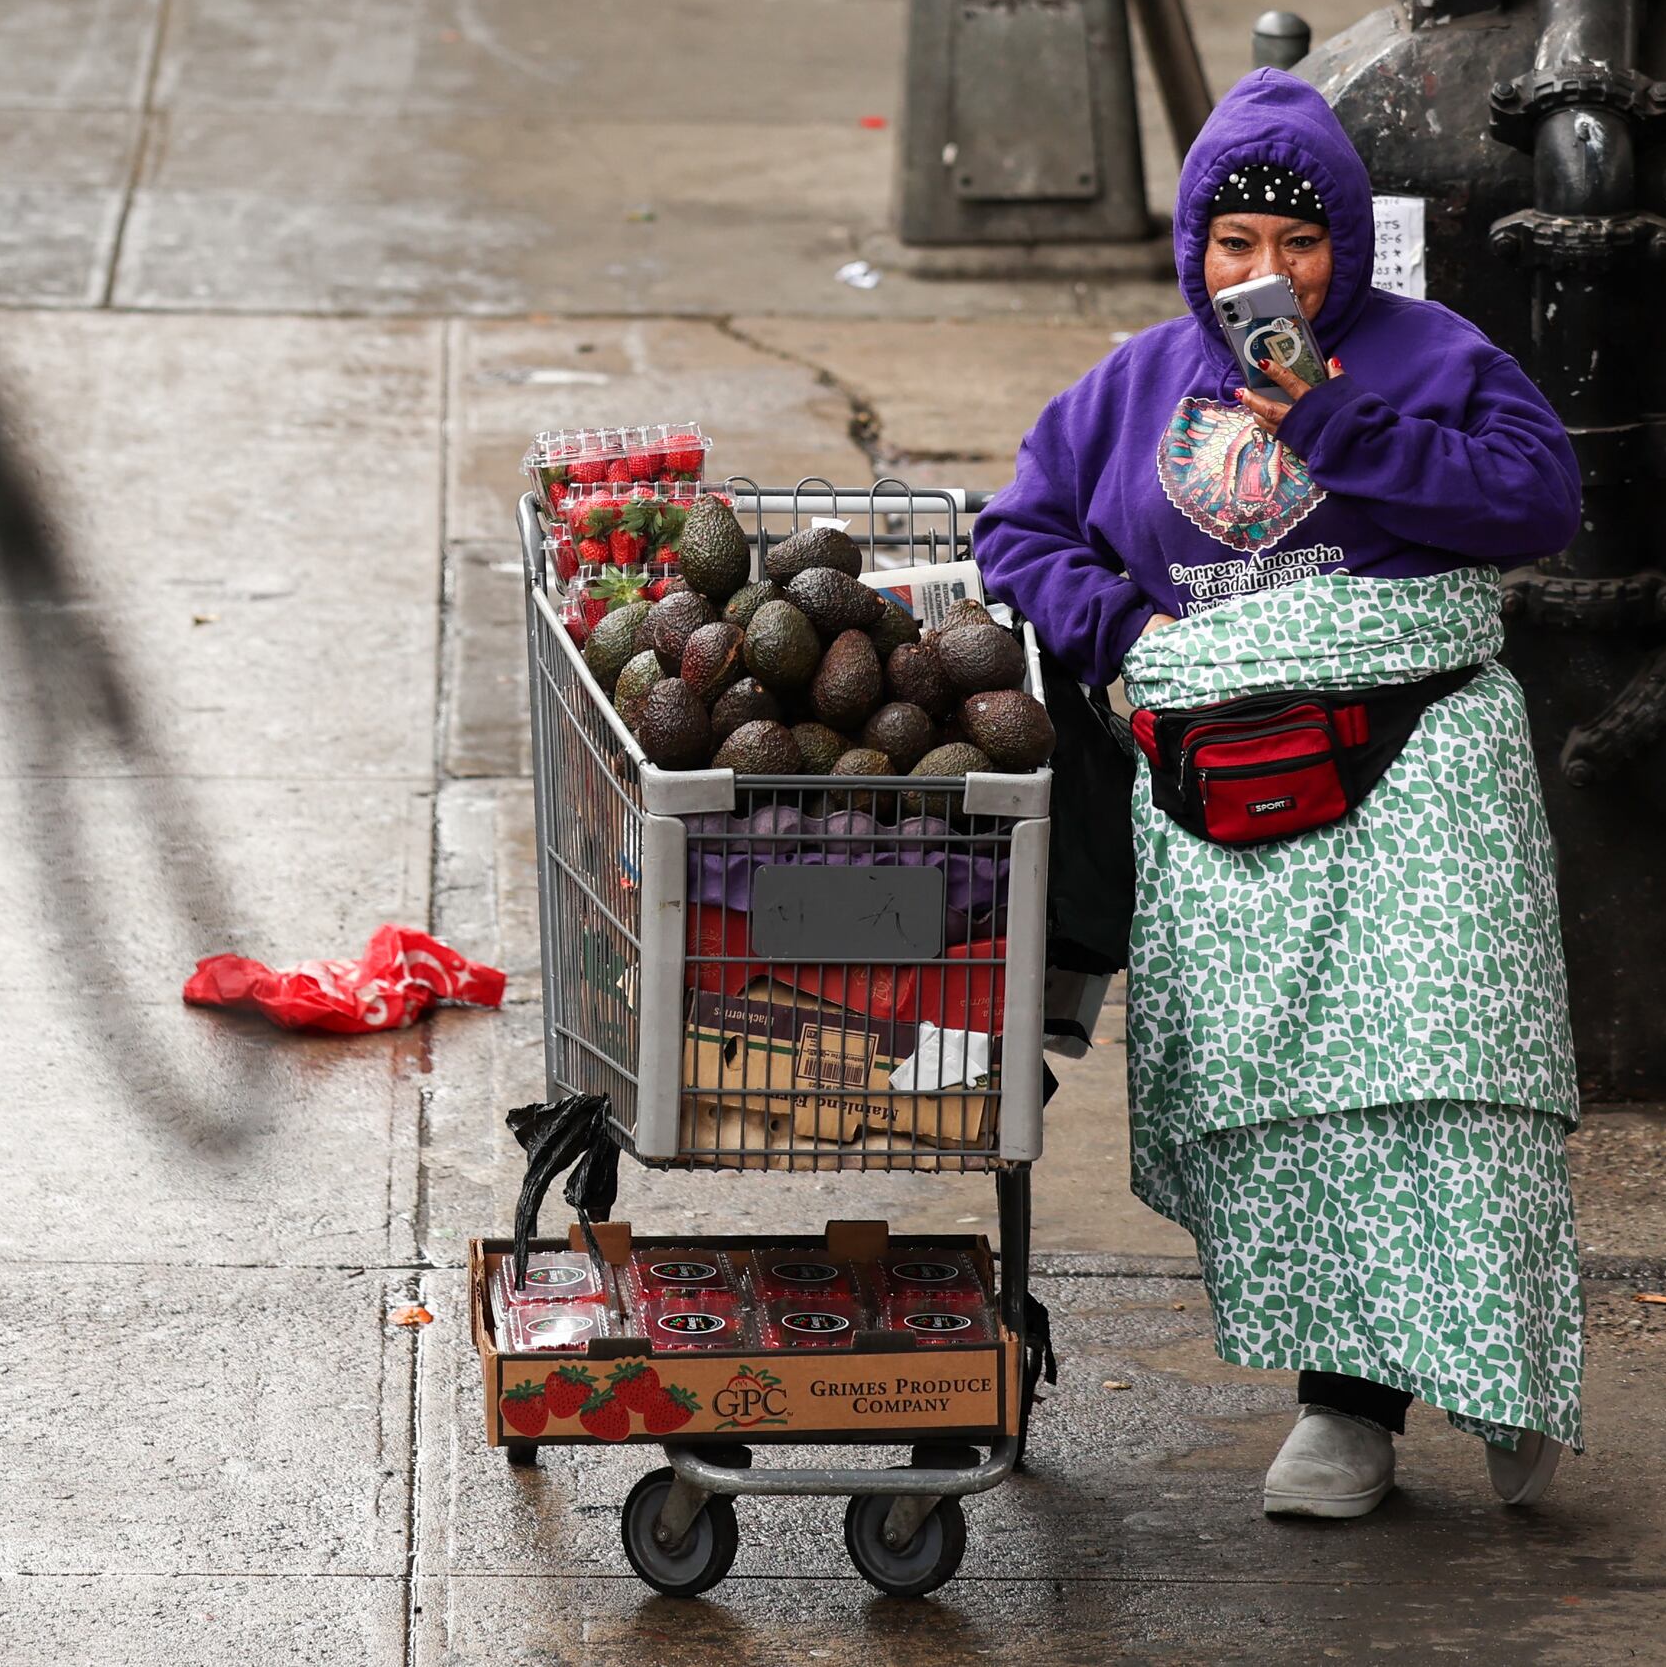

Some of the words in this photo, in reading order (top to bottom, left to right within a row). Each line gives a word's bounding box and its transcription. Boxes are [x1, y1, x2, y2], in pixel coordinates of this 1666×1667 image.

[1168, 559, 1246, 584] Carrera
[1246, 543, 1344, 575] Antorcha
[1190, 564, 1320, 599] Guadalupana
[1255, 800, 1286, 813] SPORT
[810, 1379, 887, 1397] GRIMES
[895, 1378, 992, 1394] PRODUCE
[712, 1387, 788, 1418] GPC
[852, 1397, 951, 1414] COMPANY
